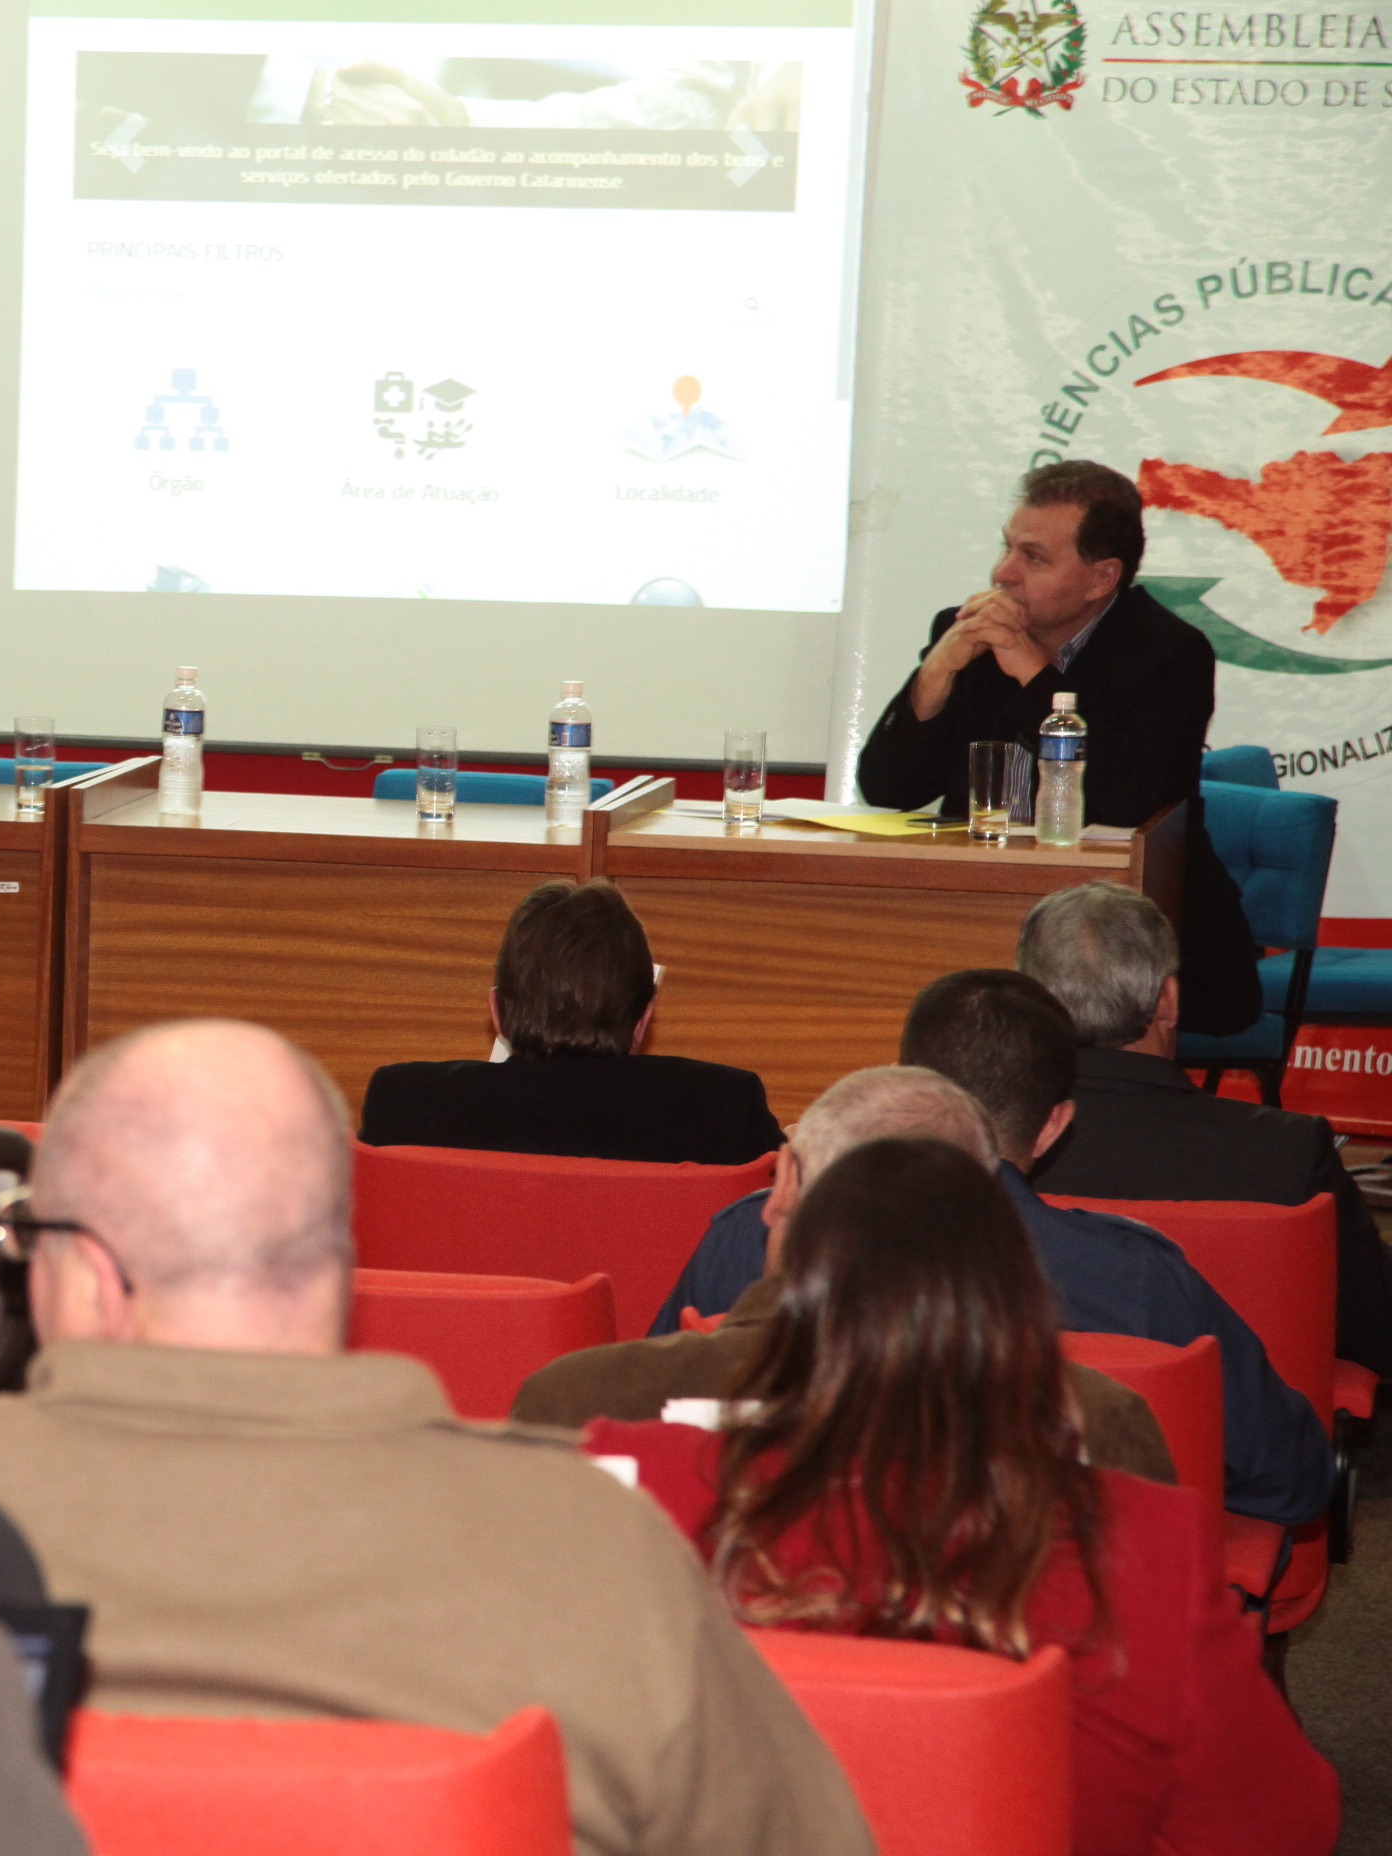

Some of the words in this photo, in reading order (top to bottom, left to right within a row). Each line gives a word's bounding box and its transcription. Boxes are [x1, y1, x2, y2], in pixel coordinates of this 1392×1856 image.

[1109, 11, 1390, 49] ASSEMBLEIA
[1102, 77, 1158, 104] DO
[1170, 78, 1308, 106] ESTADO
[1322, 79, 1368, 107] DE
[133, 143, 224, 158] bem-vindo
[228, 147, 251, 158] ao
[256, 145, 307, 163] portal
[311, 145, 335, 160] de
[339, 148, 399, 161] acesso
[402, 147, 425, 162] do
[500, 151, 525, 164] ao
[528, 151, 682, 168] acompanhamento
[685, 151, 719, 167] dos
[772, 155, 785, 168] e
[240, 168, 309, 187] serviços
[314, 170, 398, 185] ofertados
[402, 171, 440, 189] pelo
[445, 171, 516, 187] Governo
[87, 240, 197, 260] PRINCIPAIS
[205, 243, 286, 262] FILTROS
[148, 470, 205, 496] Órgão
[340, 478, 385, 499] Área
[391, 483, 415, 499] de
[422, 484, 500, 505] Atuação
[614, 484, 721, 503] Localidade
